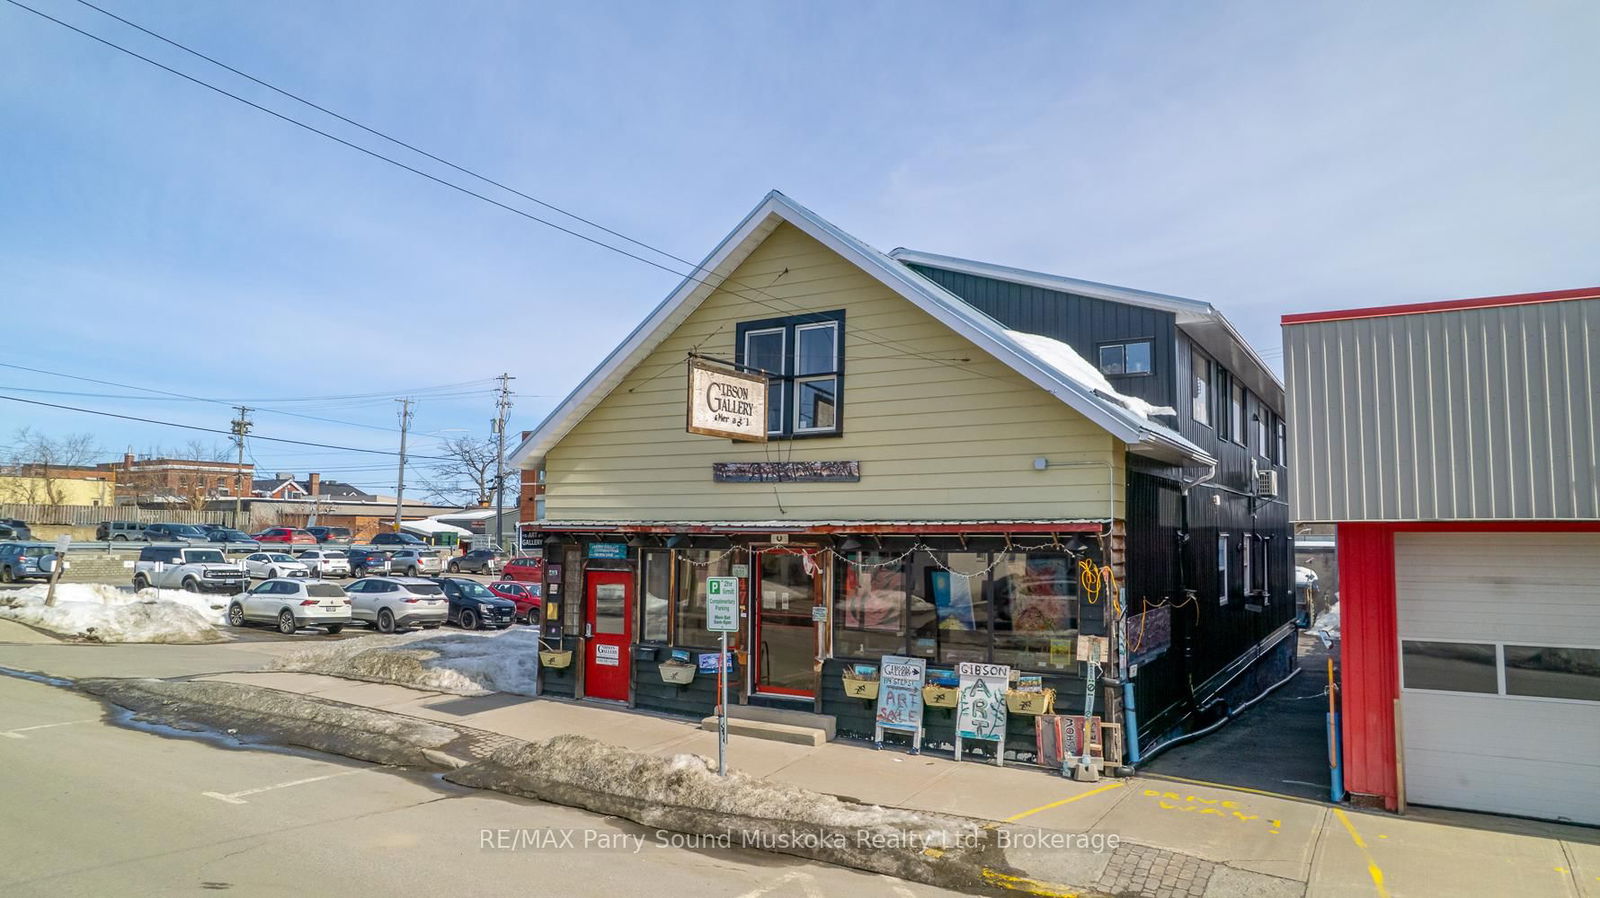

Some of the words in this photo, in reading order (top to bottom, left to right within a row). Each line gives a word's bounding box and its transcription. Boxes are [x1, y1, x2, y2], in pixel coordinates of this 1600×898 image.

[961, 664, 1007, 676] GIBSON
[887, 690, 919, 708] ART
[969, 678, 992, 738] ART
[881, 707, 918, 722] SALE
[1144, 789, 1240, 809] DRIVE
